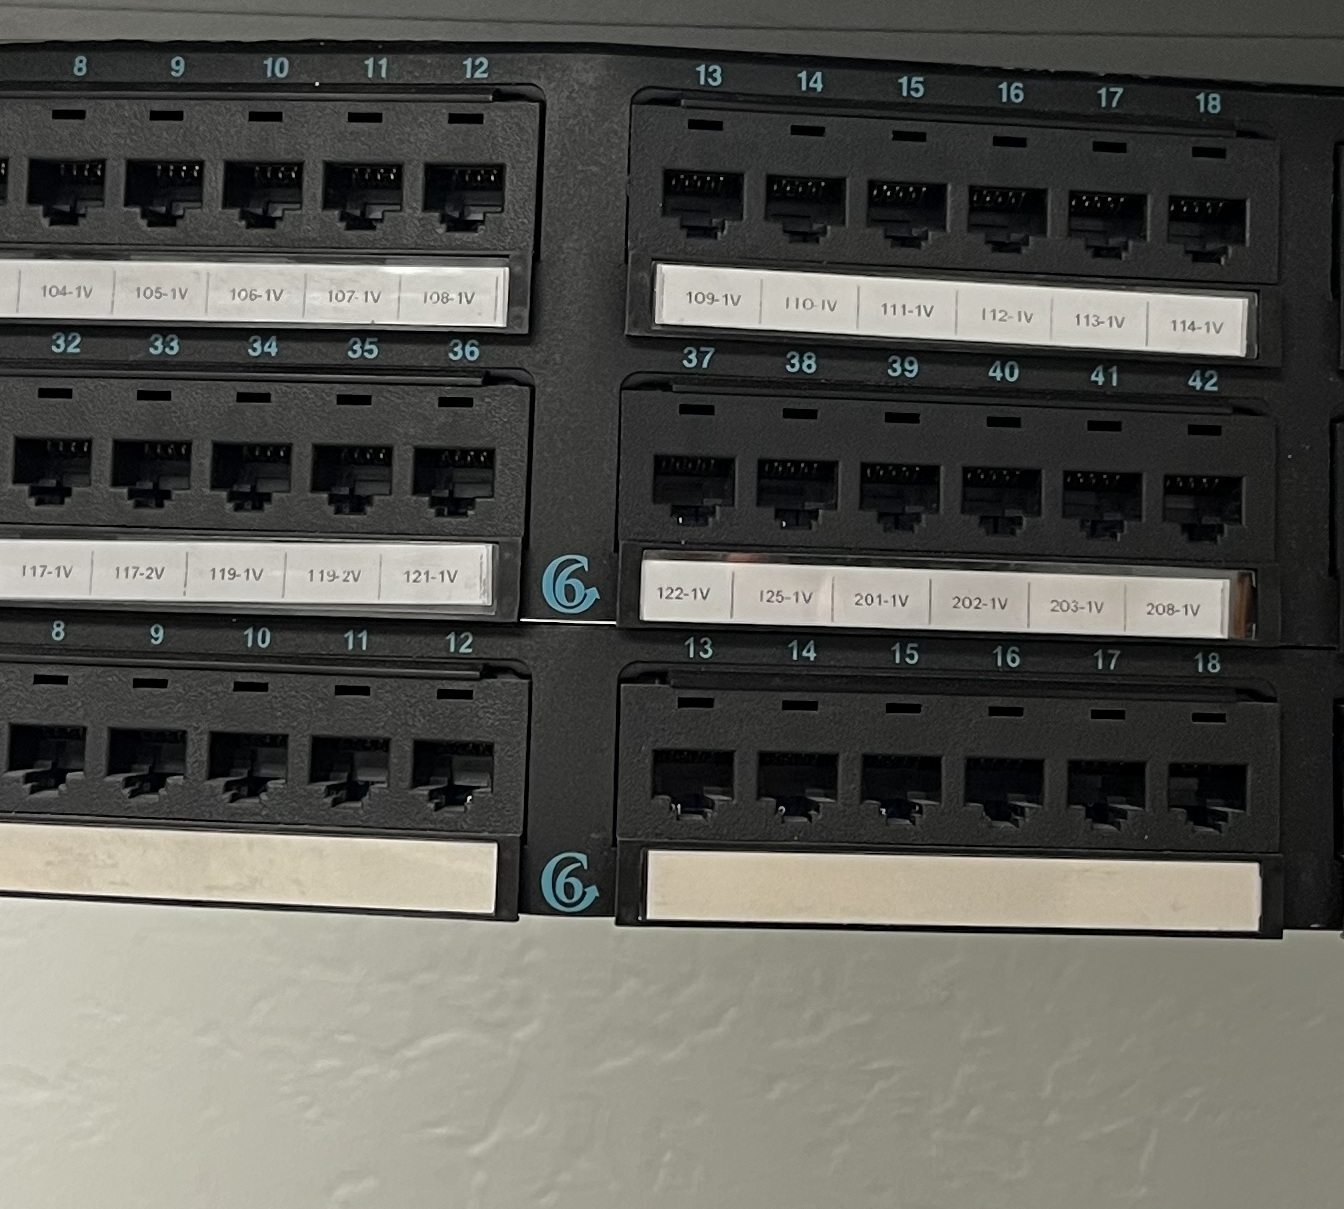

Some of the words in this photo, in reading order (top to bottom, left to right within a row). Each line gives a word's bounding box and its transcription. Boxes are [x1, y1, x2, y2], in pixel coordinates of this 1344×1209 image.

[72, 55, 88, 77] 8
[170, 55, 186, 78] 9
[263, 56, 290, 79] 10
[364, 56, 388, 79] 11
[462, 56, 489, 79] 12
[695, 63, 723, 87] 13
[797, 70, 824, 93] 14
[897, 75, 925, 98] 15
[997, 81, 1025, 104] 16
[1096, 86, 1124, 108] 17
[1195, 91, 1222, 114] 18
[40, 284, 94, 299] 104-1V
[135, 286, 189, 301] 105-1V
[229, 287, 285, 302] 106-1V
[685, 290, 742, 307] 109-1V
[881, 302, 935, 318] 111-1V
[1075, 313, 1126, 329] 113-1V
[1170, 319, 1225, 335] 114-1V
[51, 332, 82, 354] 32
[148, 337, 180, 356] 33
[247, 335, 278, 357] 34
[347, 338, 379, 359] 35
[447, 339, 480, 362] 36
[682, 346, 715, 369] 37
[785, 351, 817, 374] 38
[887, 355, 919, 378] 39
[988, 360, 1020, 383] 40
[1090, 365, 1118, 387] 41
[1187, 369, 1219, 392] 42
[22, 564, 74, 579] 117-1V
[115, 565, 166, 580] 117-2V
[210, 567, 264, 582] 119-1V
[403, 569, 459, 584] 121-1V
[657, 586, 711, 602] 122-1V
[854, 592, 910, 608] 201-1V
[951, 595, 1009, 611] 202-1V
[1146, 602, 1201, 618] 208-1V
[51, 620, 65, 642] 8
[149, 624, 164, 645] 9
[243, 627, 271, 649] 10
[343, 630, 368, 651] 11
[445, 631, 473, 654] 12
[684, 636, 713, 659] 13
[788, 639, 817, 662] 14
[891, 642, 919, 665] 15
[992, 645, 1021, 668] 16
[1093, 649, 1121, 671] 17
[1194, 652, 1221, 674] 18
